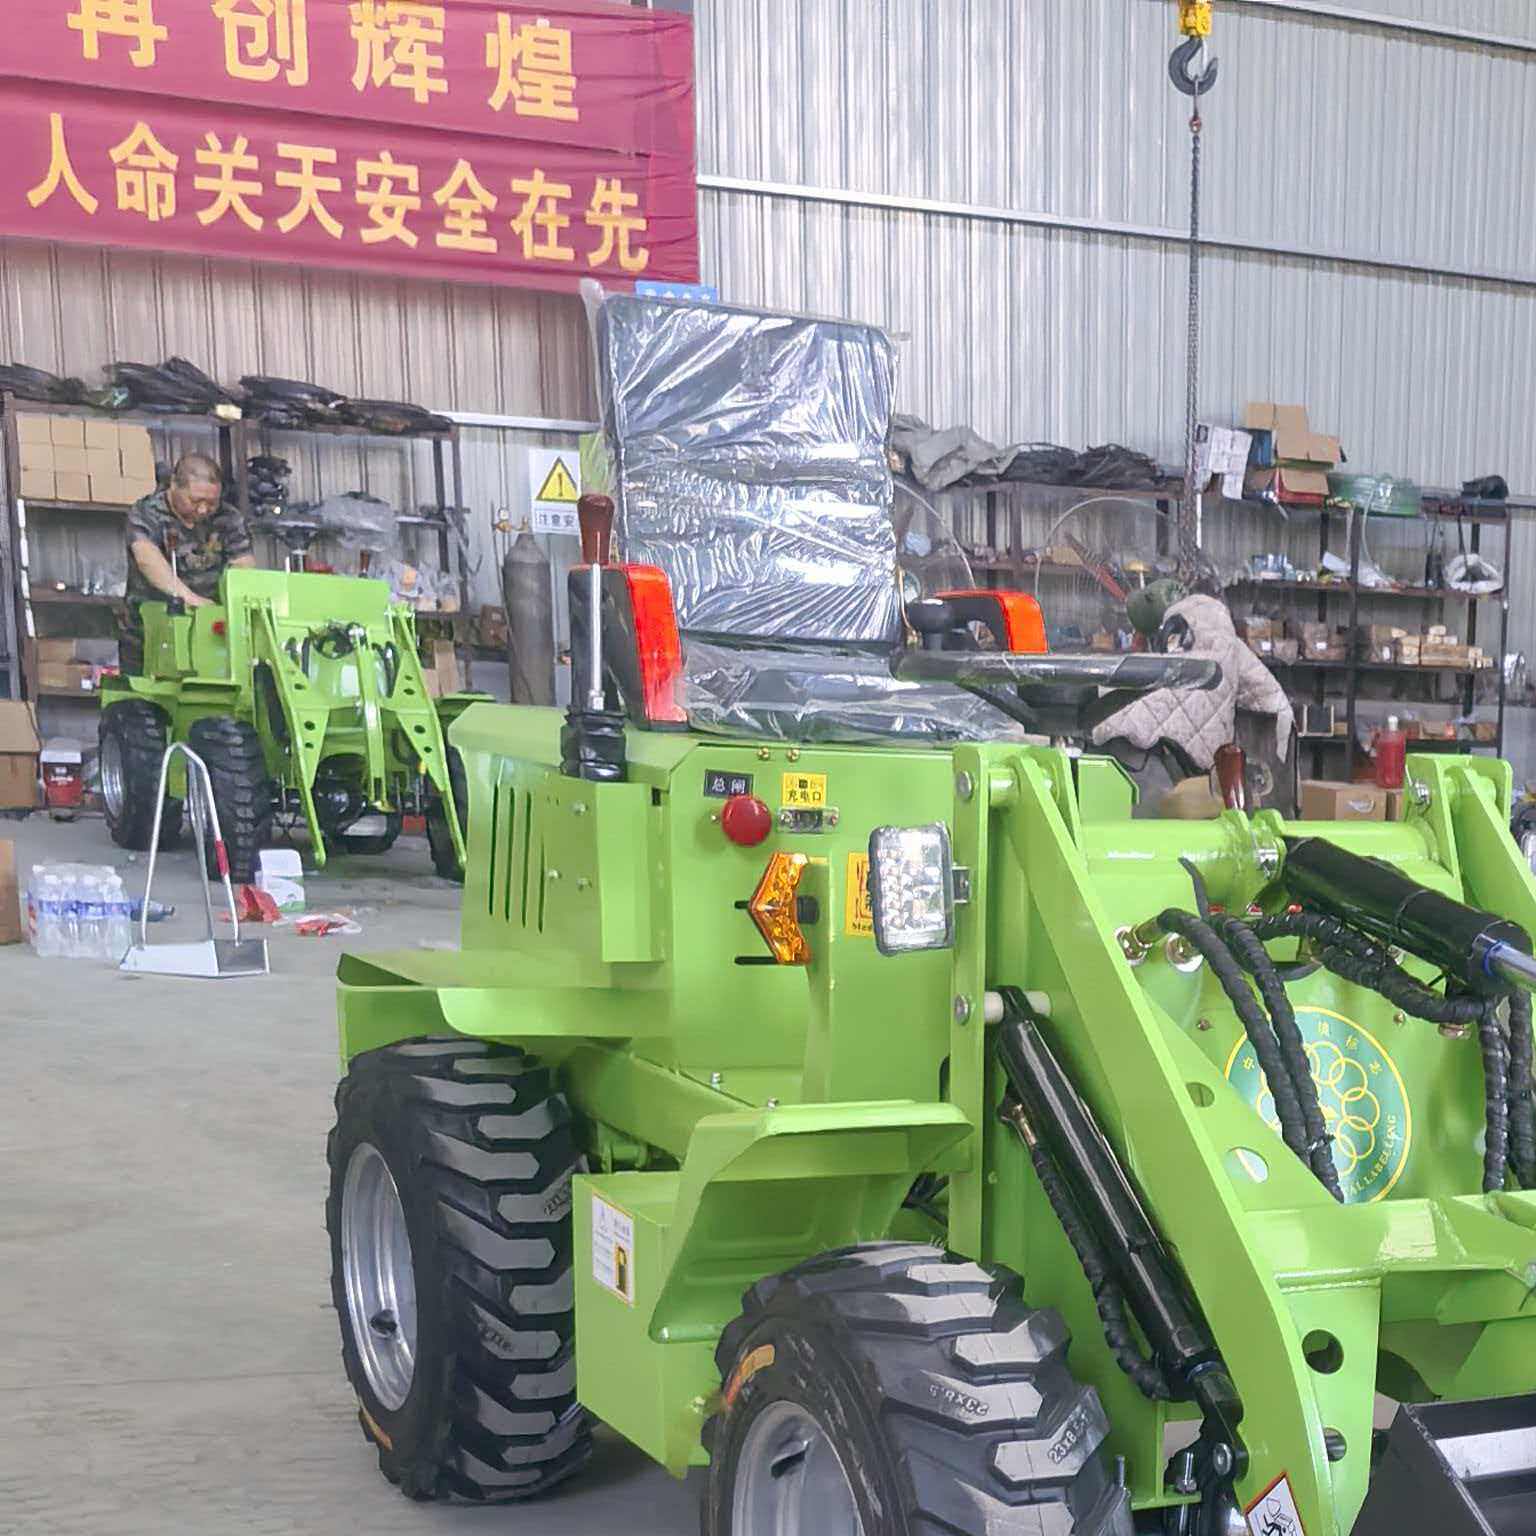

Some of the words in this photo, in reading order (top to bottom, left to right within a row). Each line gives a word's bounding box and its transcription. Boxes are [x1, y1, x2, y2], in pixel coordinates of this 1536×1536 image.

[66, 0, 580, 122] 再创辉煌
[26, 112, 650, 272] 人命关天安全在先
[788, 789, 822, 802] 充电口
